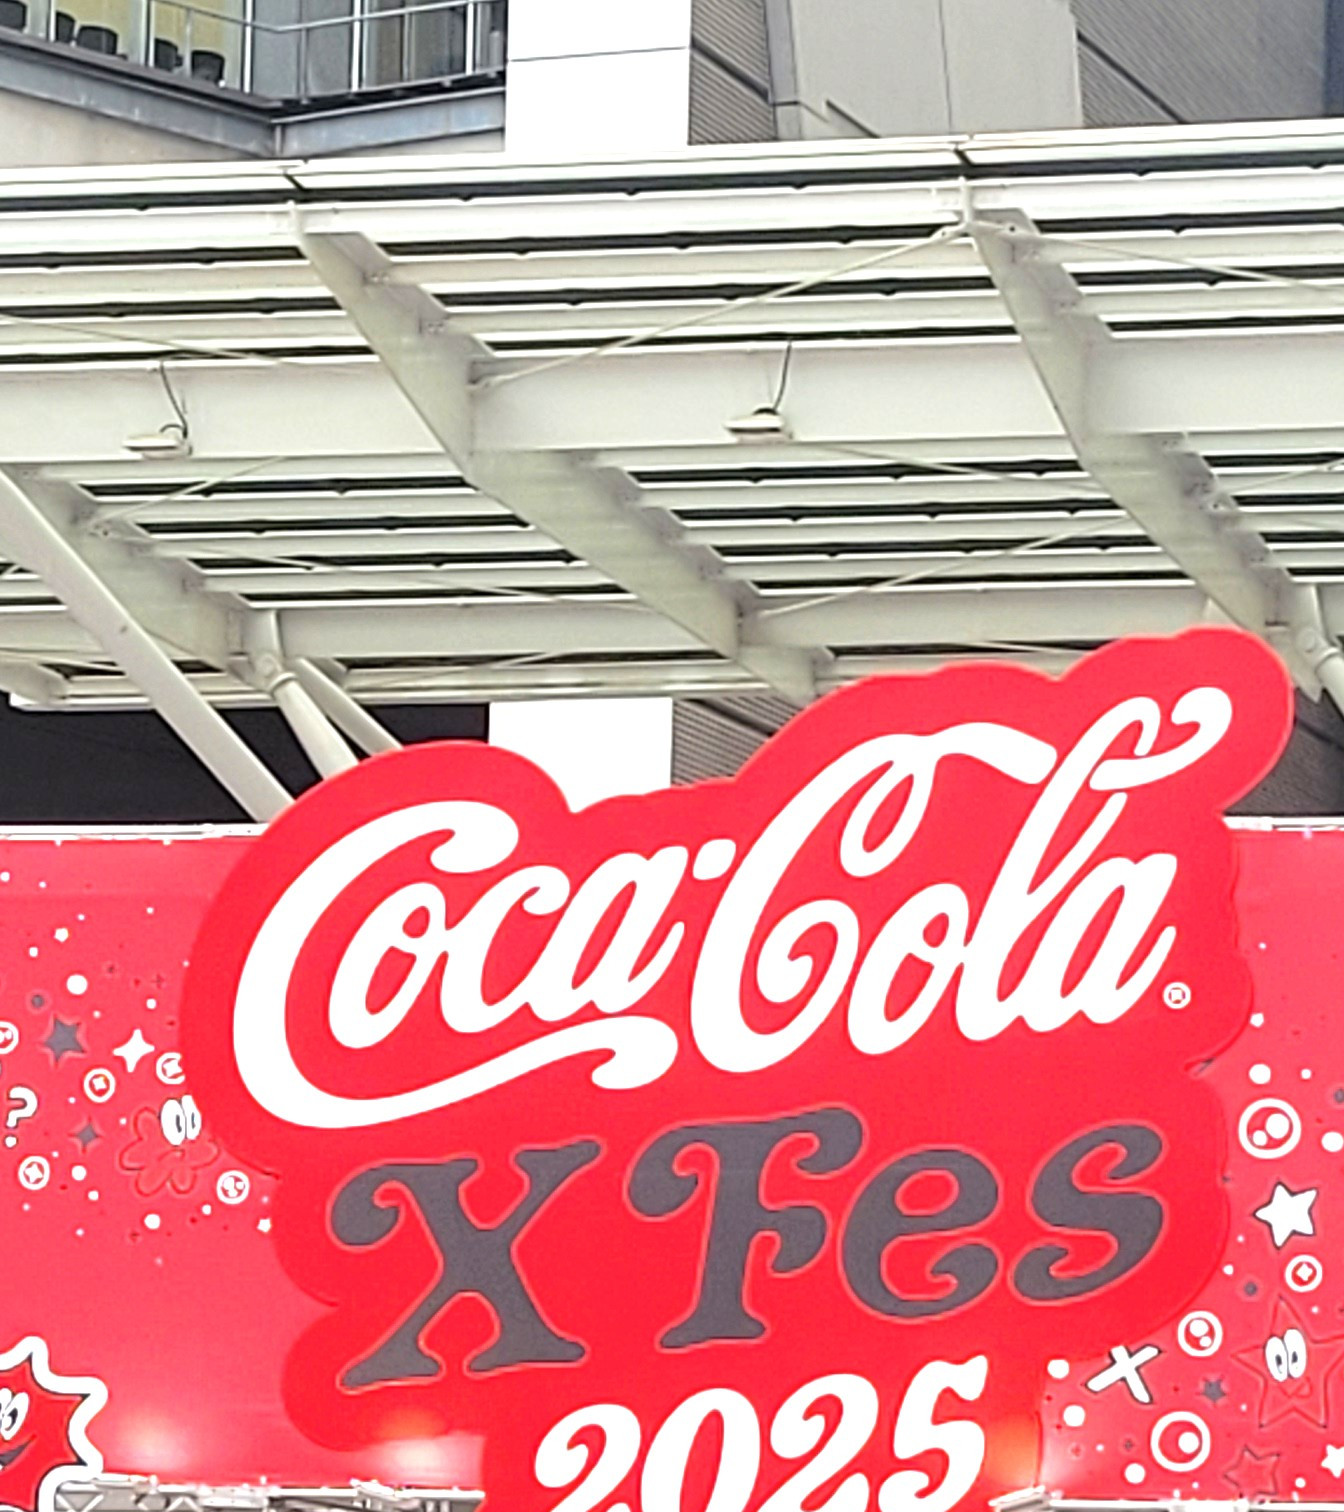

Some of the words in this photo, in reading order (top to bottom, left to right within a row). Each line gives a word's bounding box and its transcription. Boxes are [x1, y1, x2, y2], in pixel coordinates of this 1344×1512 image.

[233, 686, 1232, 1128] Coca-Cola
[330, 1138, 604, 1390] X
[625, 1106, 1165, 1350] Fes
